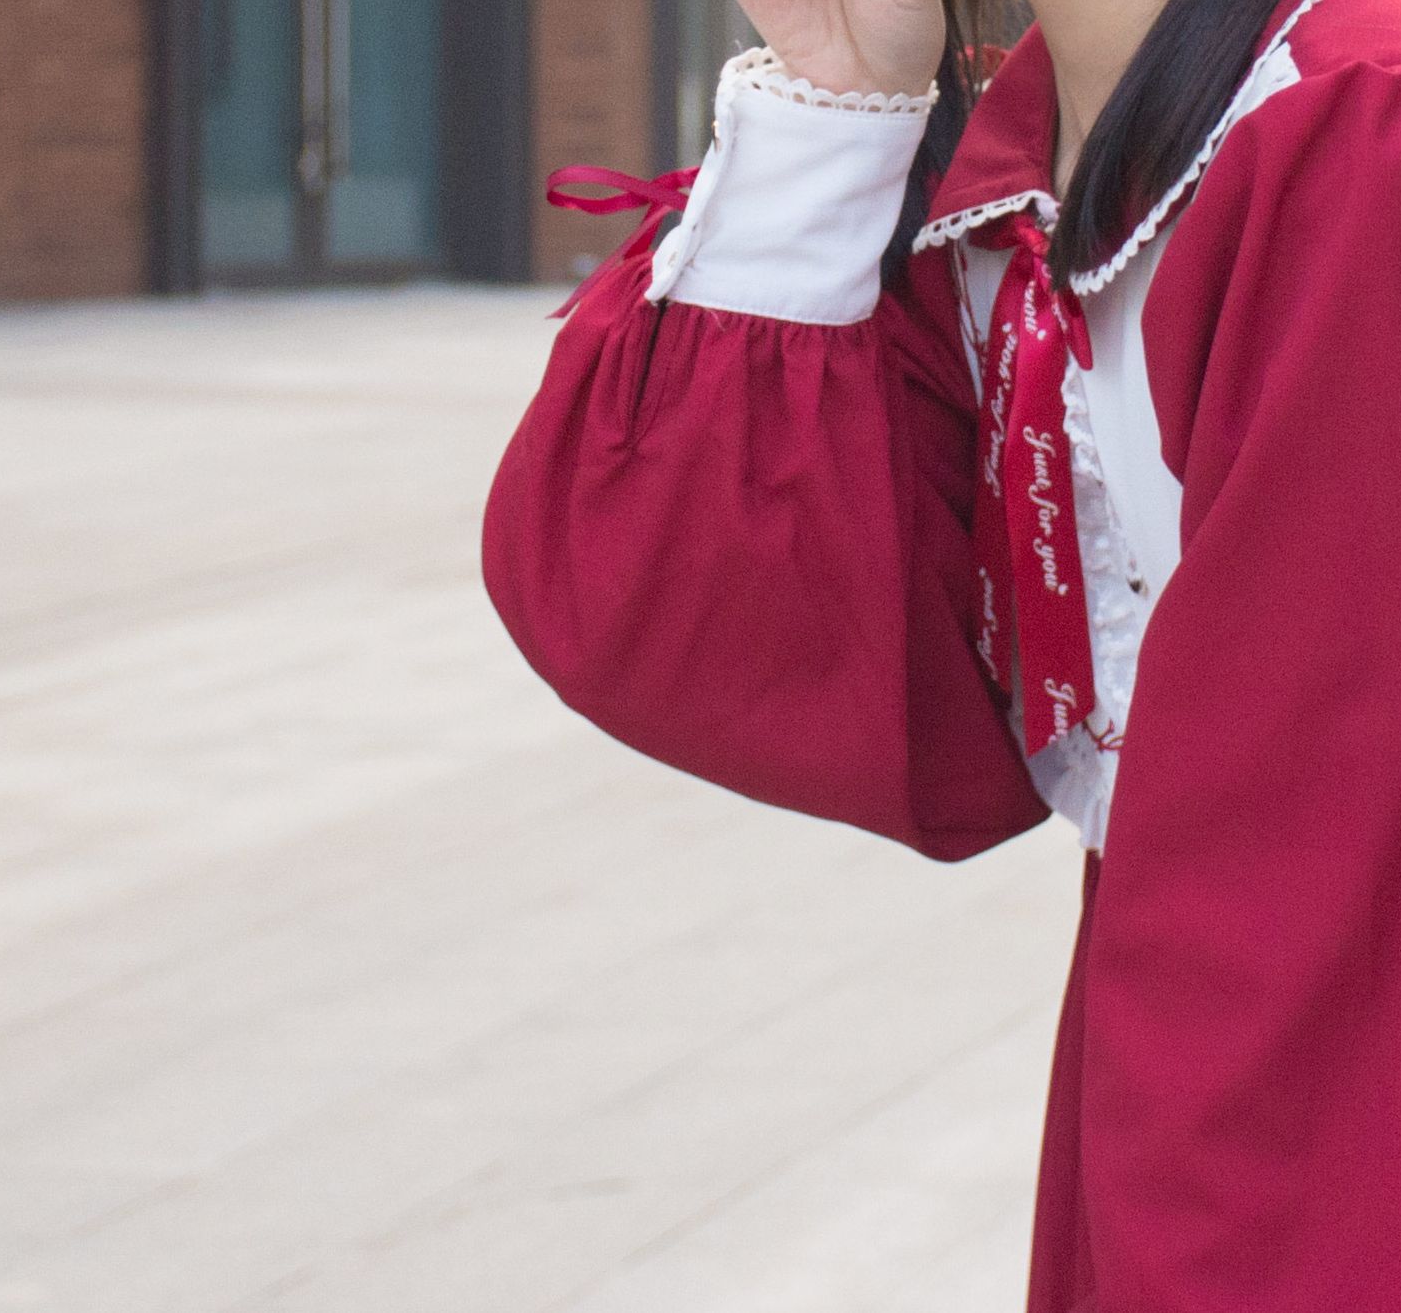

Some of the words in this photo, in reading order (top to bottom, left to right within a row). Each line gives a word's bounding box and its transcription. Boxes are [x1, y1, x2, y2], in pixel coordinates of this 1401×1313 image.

[998, 333, 1019, 390] you
[1023, 425, 1057, 490] Just
[1028, 484, 1060, 537] for
[1033, 537, 1059, 591] you
